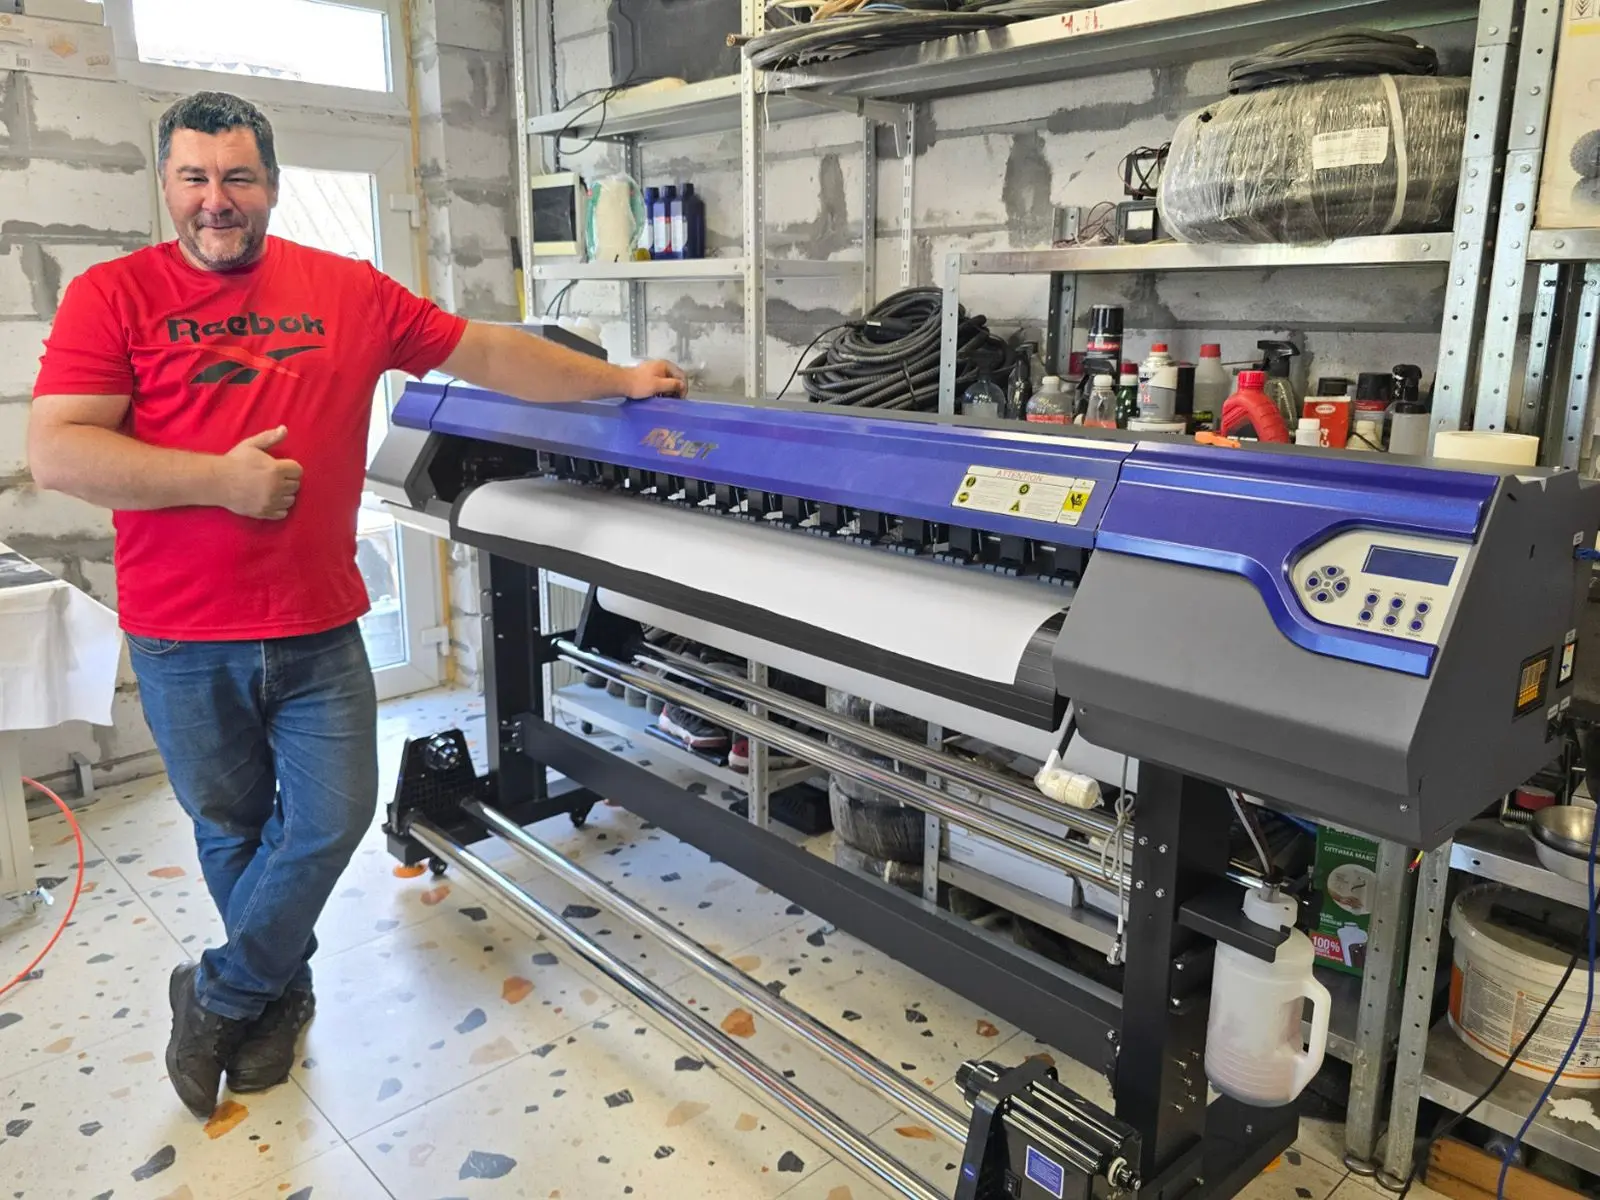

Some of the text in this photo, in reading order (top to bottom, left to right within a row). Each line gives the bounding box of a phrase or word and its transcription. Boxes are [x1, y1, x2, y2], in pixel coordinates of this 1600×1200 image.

[167, 312, 325, 344] Reebok
[996, 470, 1043, 482] ATTENTION
[1312, 935, 1341, 953] 100%
